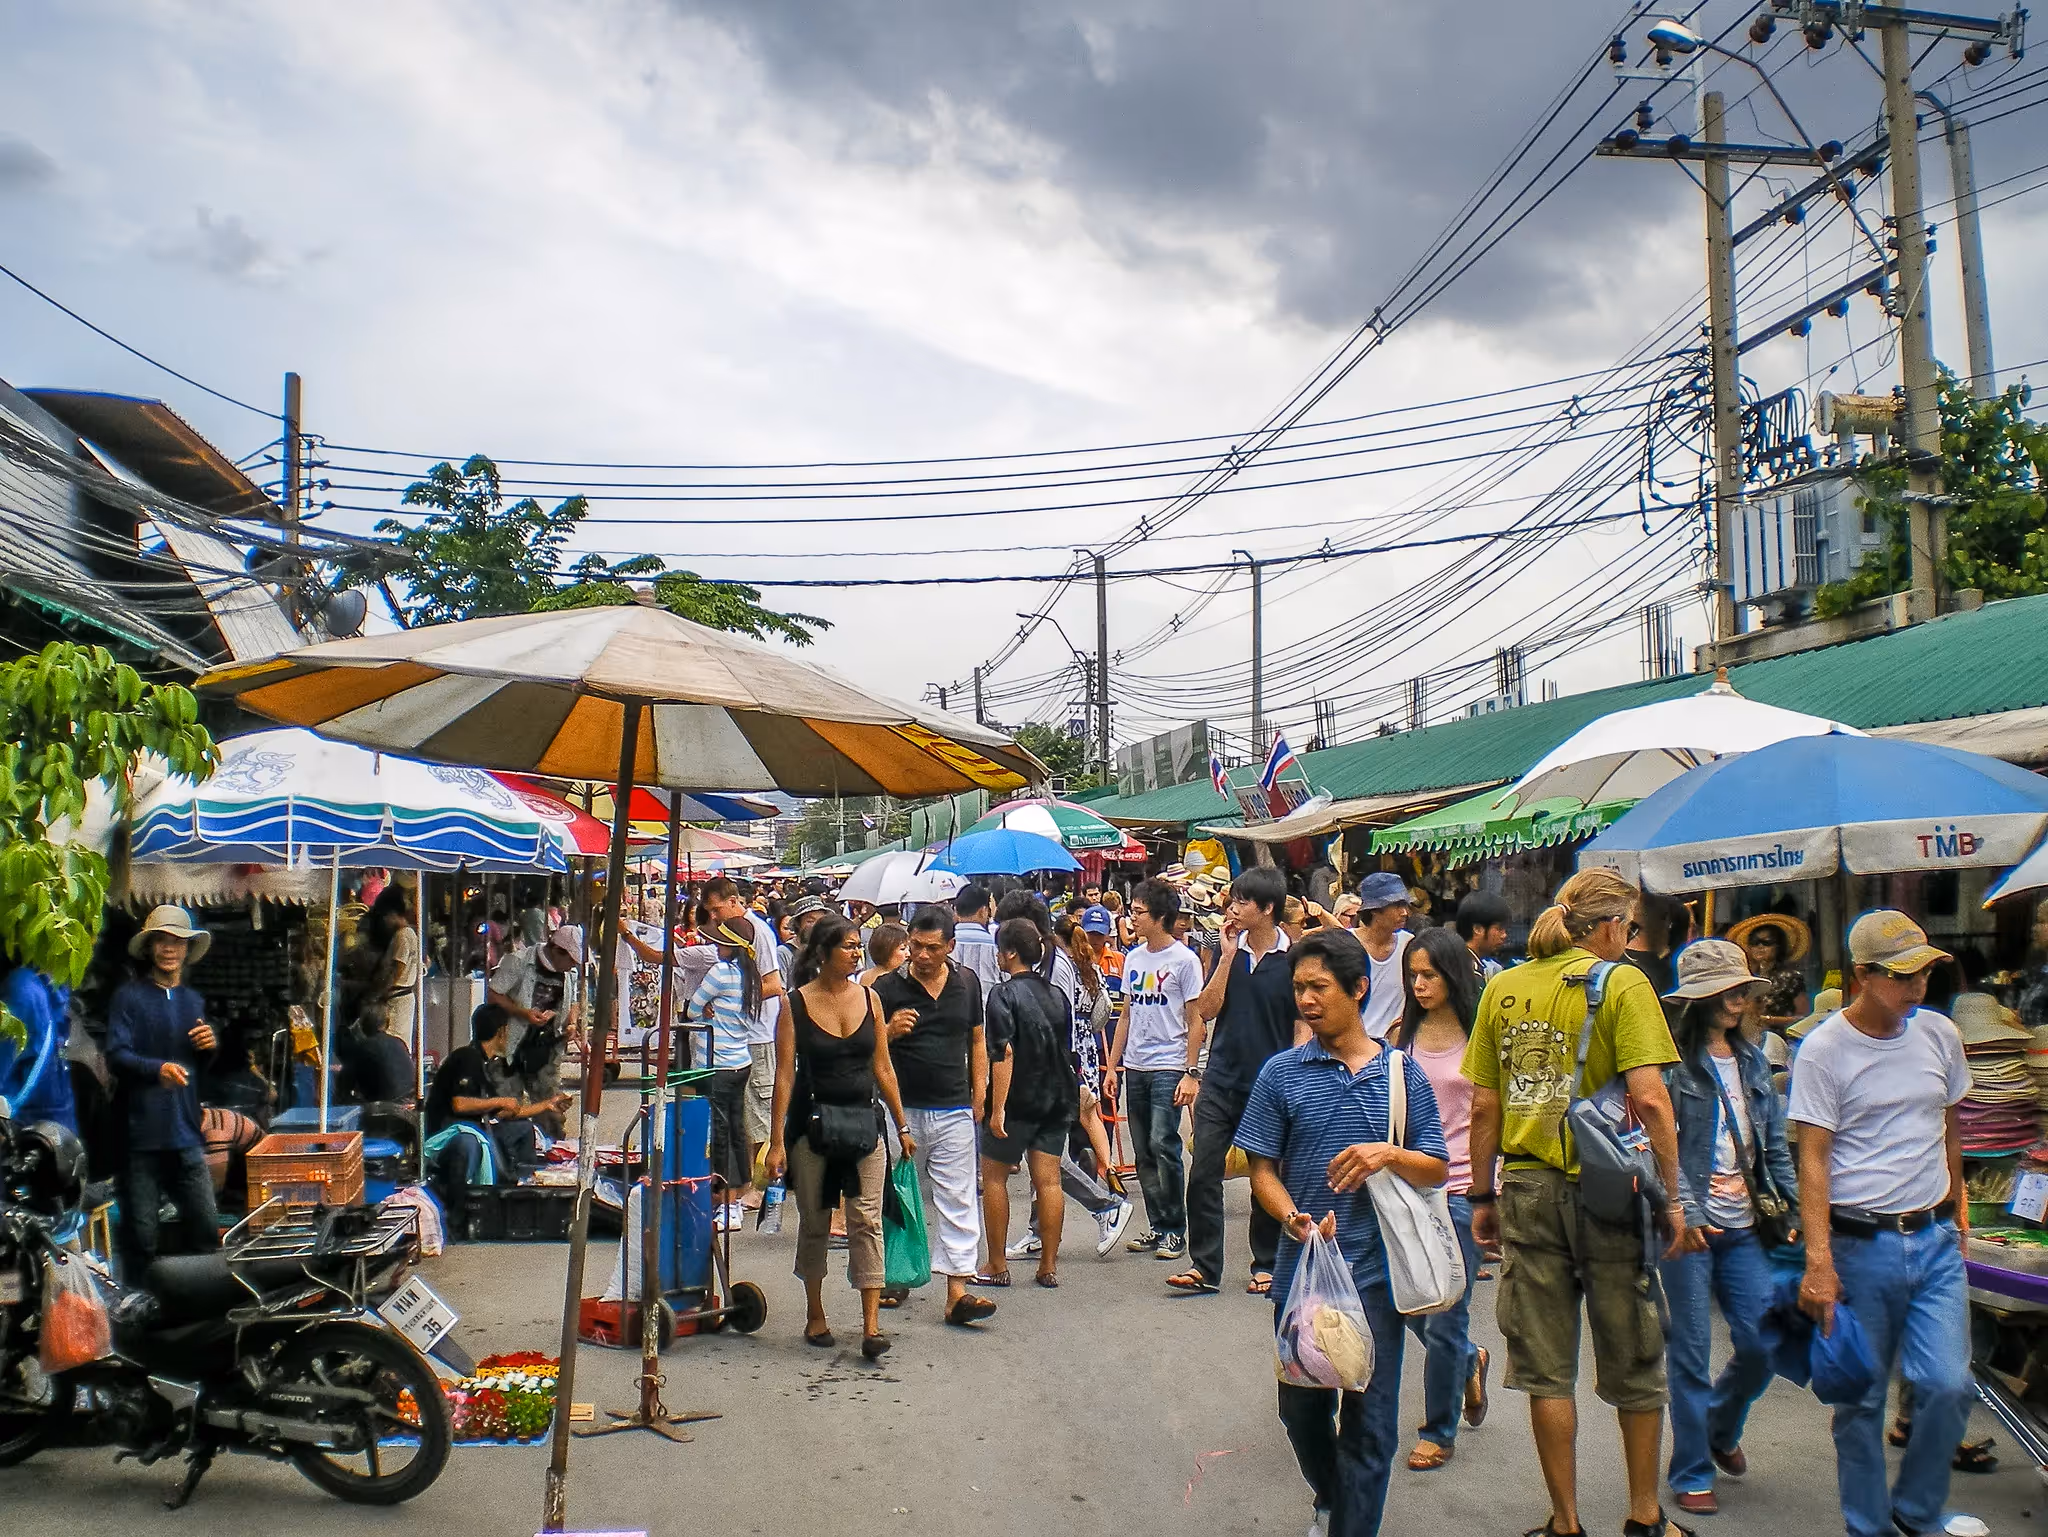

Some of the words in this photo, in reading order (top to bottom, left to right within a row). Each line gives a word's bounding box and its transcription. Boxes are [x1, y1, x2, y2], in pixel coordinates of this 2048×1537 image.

[1080, 834, 1112, 845] Manulife
[1916, 824, 1984, 857] TMB
[1682, 844, 1804, 878] ธนาคารทหารไทย
